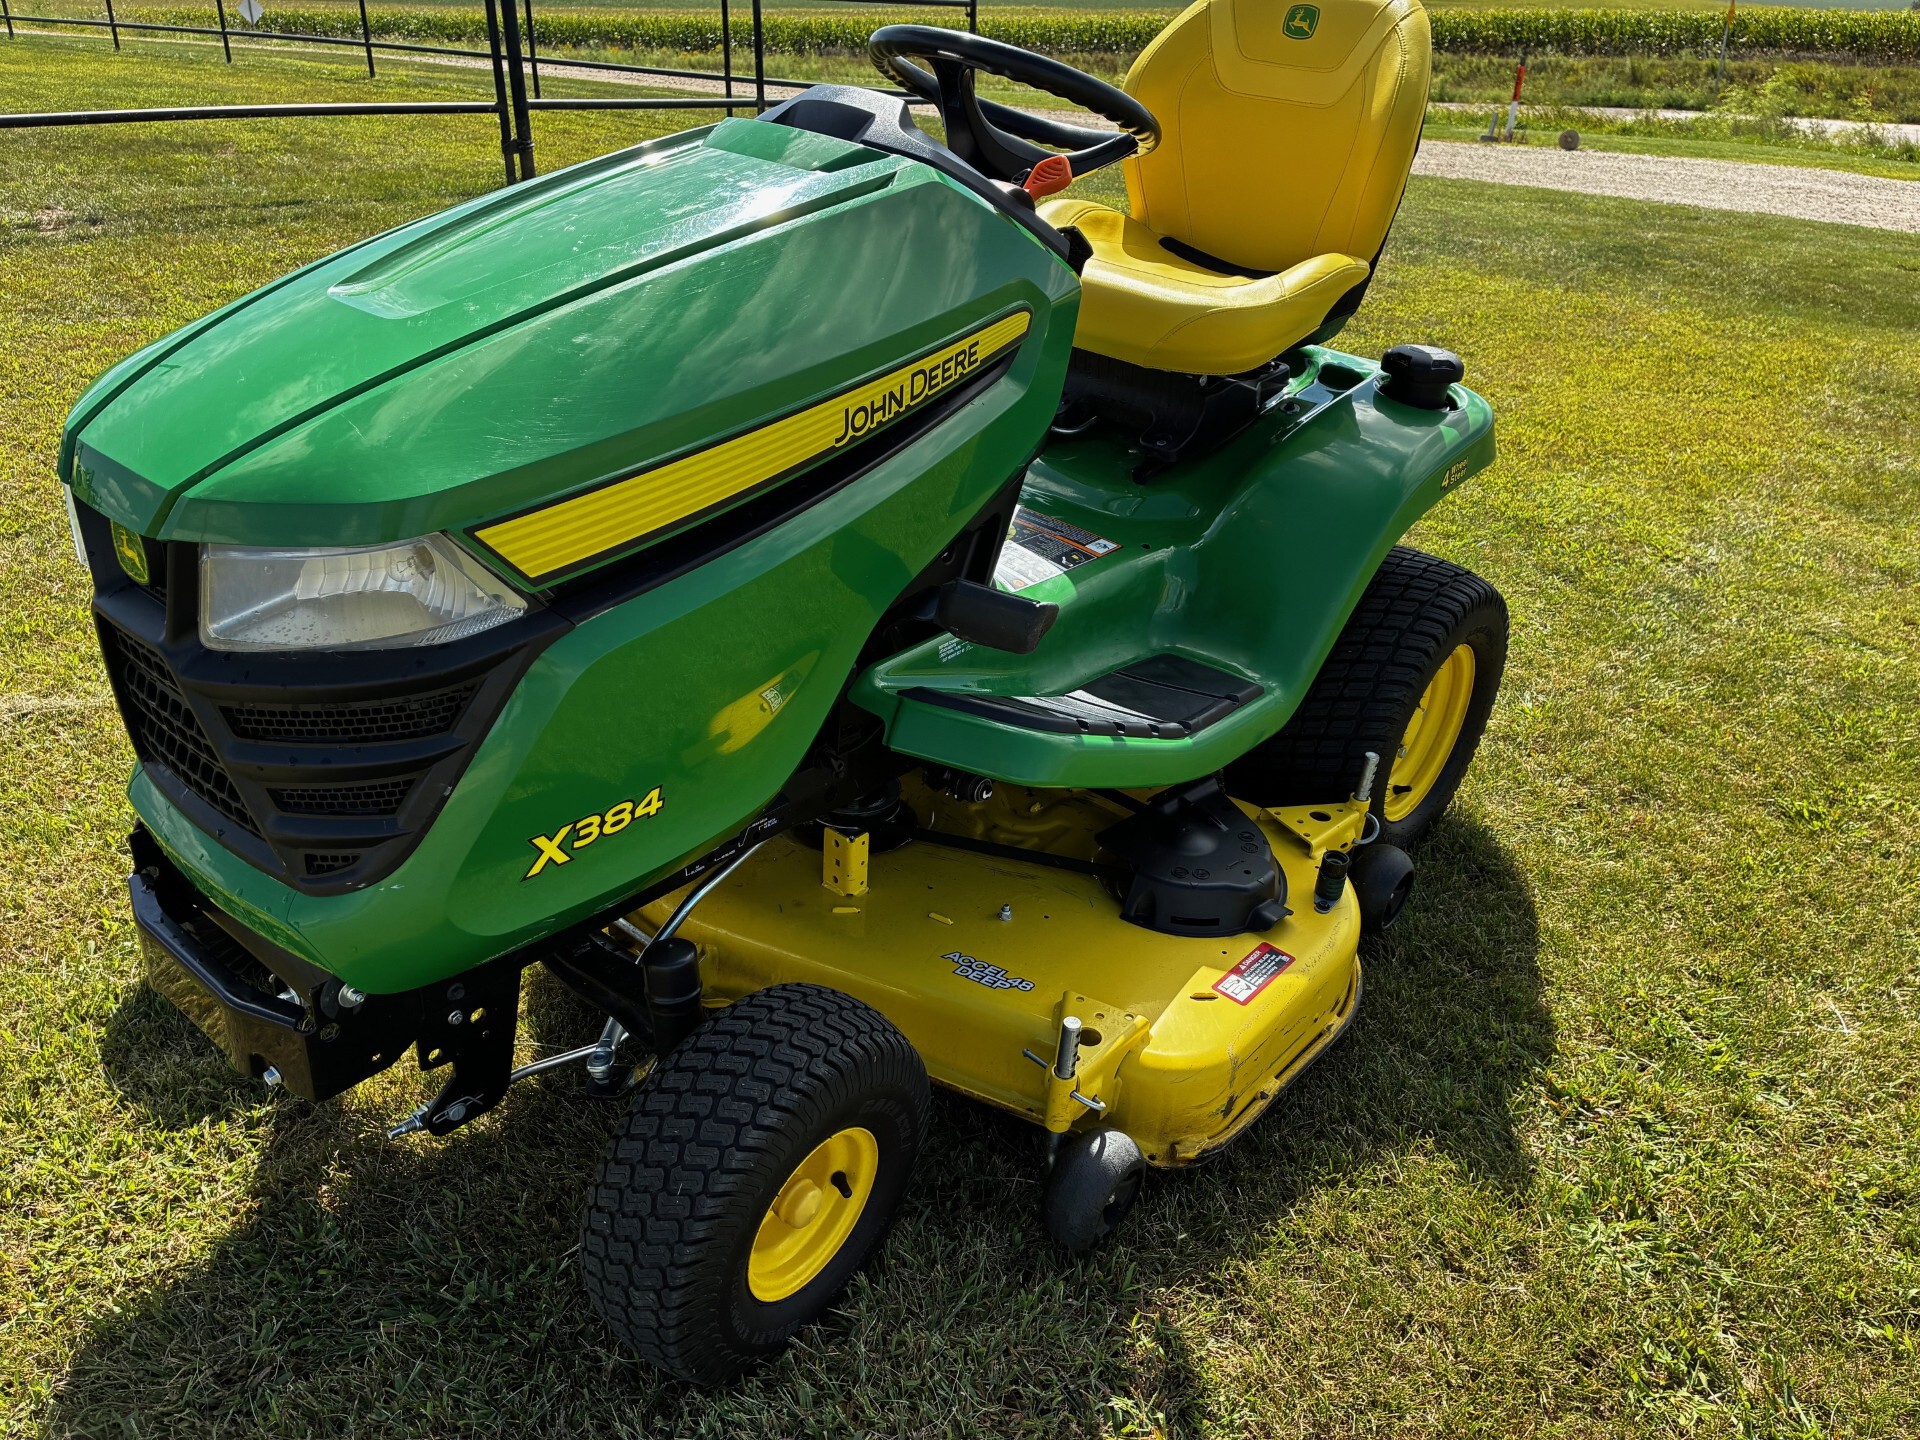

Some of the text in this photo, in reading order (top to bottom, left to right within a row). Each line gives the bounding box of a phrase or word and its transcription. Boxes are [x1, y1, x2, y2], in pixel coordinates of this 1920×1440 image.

[834, 340, 980, 447] JOHN DEERE
[1441, 469, 1450, 488] 4
[522, 785, 664, 881] X384
[940, 951, 1008, 980] ACCEL
[952, 965, 1035, 992] DEEP 48
